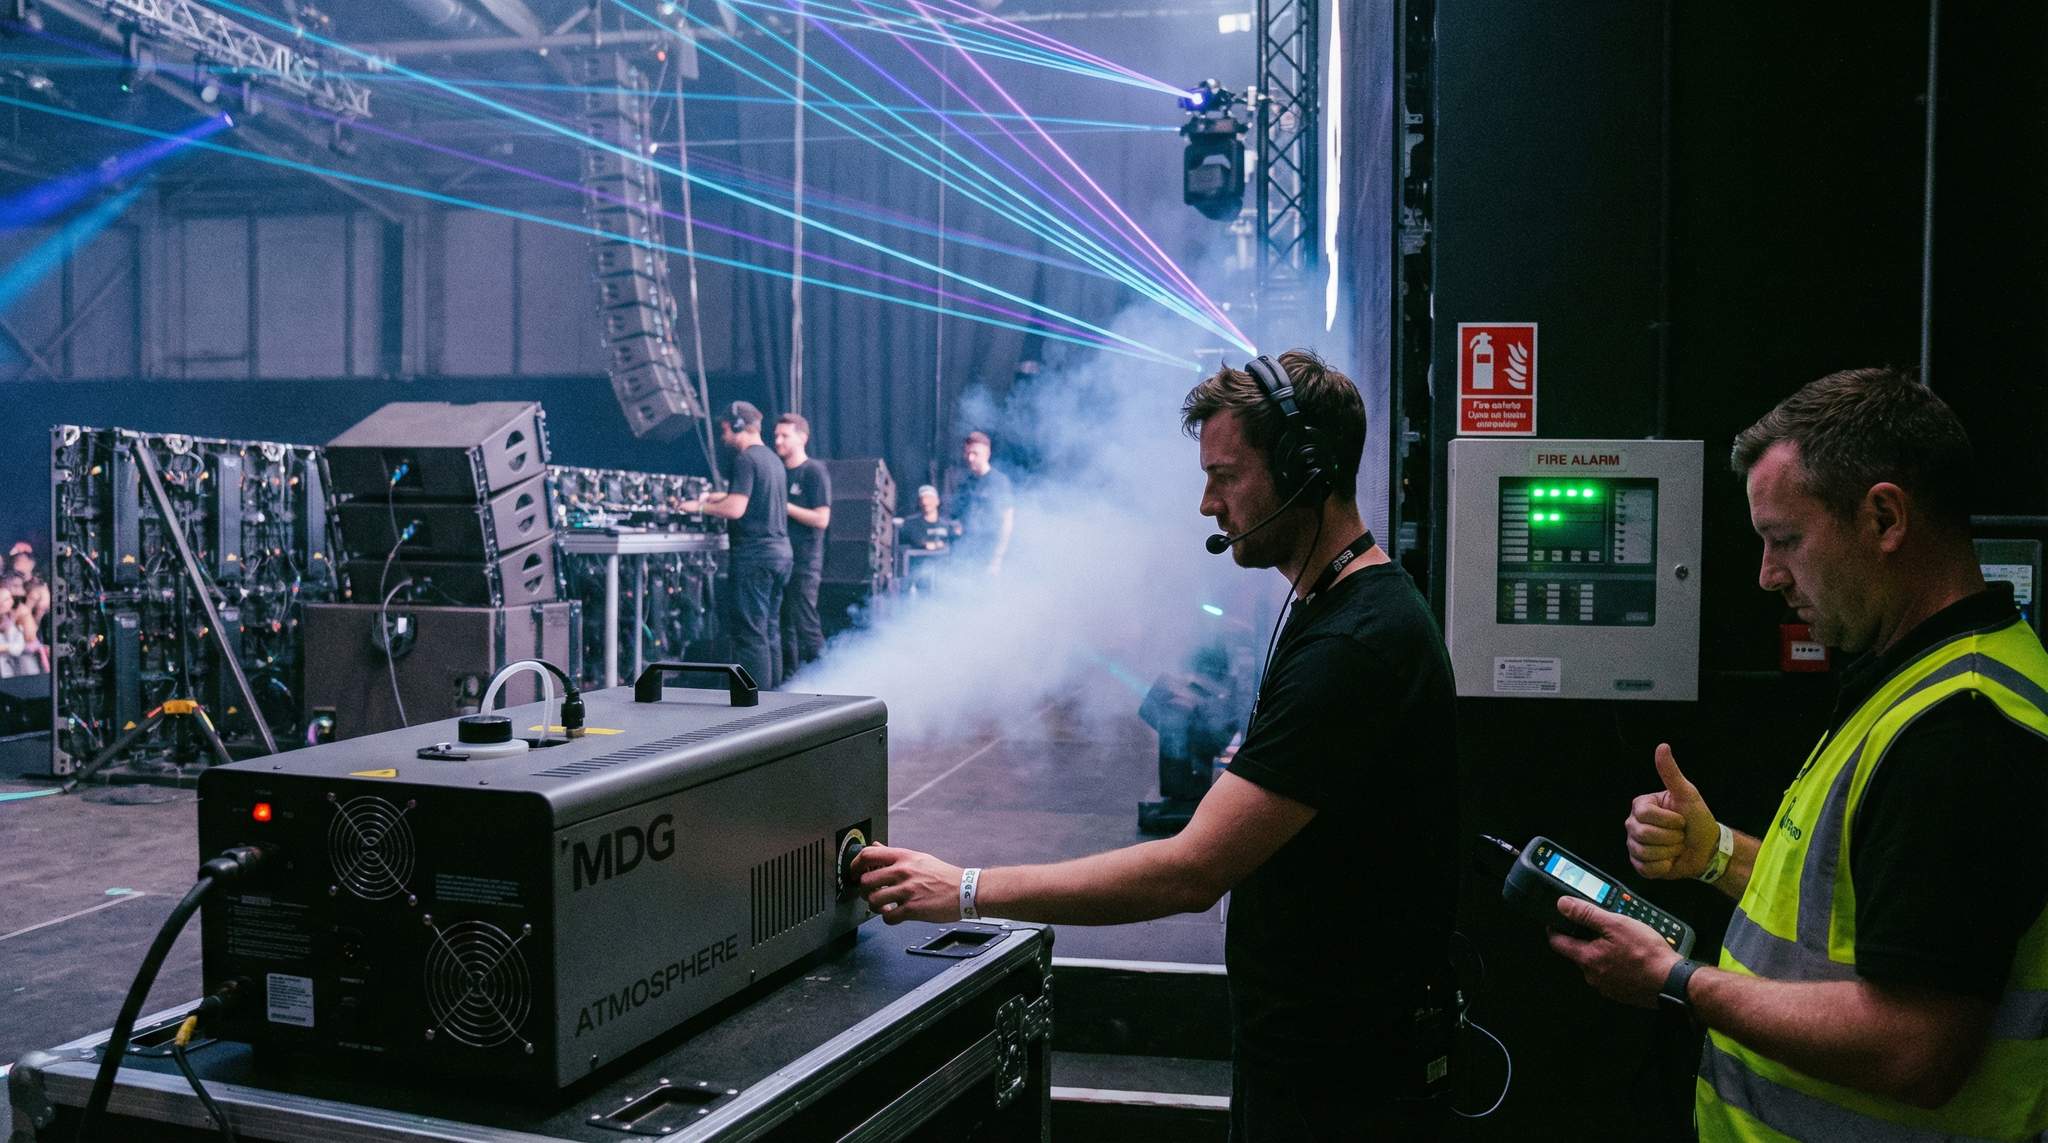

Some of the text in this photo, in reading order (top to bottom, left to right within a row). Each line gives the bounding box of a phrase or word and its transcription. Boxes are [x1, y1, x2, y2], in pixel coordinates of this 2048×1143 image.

[1537, 454, 1620, 466] FIRE ALARM
[573, 814, 675, 892] MDG
[575, 933, 738, 1038] ATMOSPHERE
